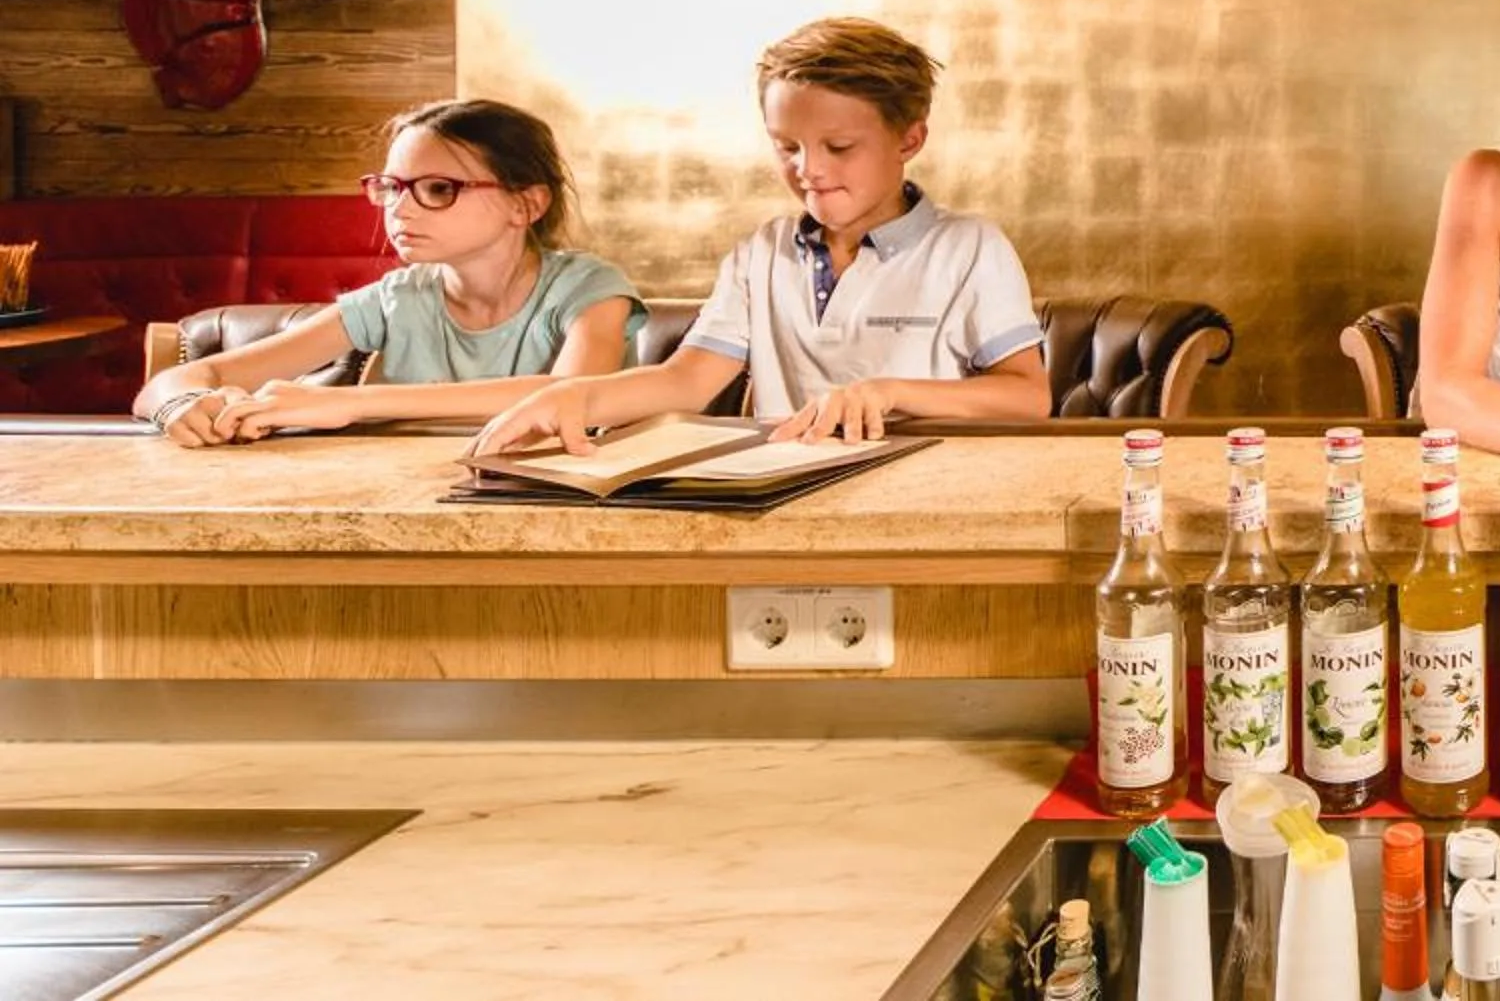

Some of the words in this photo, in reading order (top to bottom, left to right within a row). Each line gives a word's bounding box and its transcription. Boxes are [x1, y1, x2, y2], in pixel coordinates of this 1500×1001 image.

[1100, 658, 1157, 676] ONIN
[1206, 648, 1279, 671] MONIN
[1311, 648, 1383, 672] MONIN
